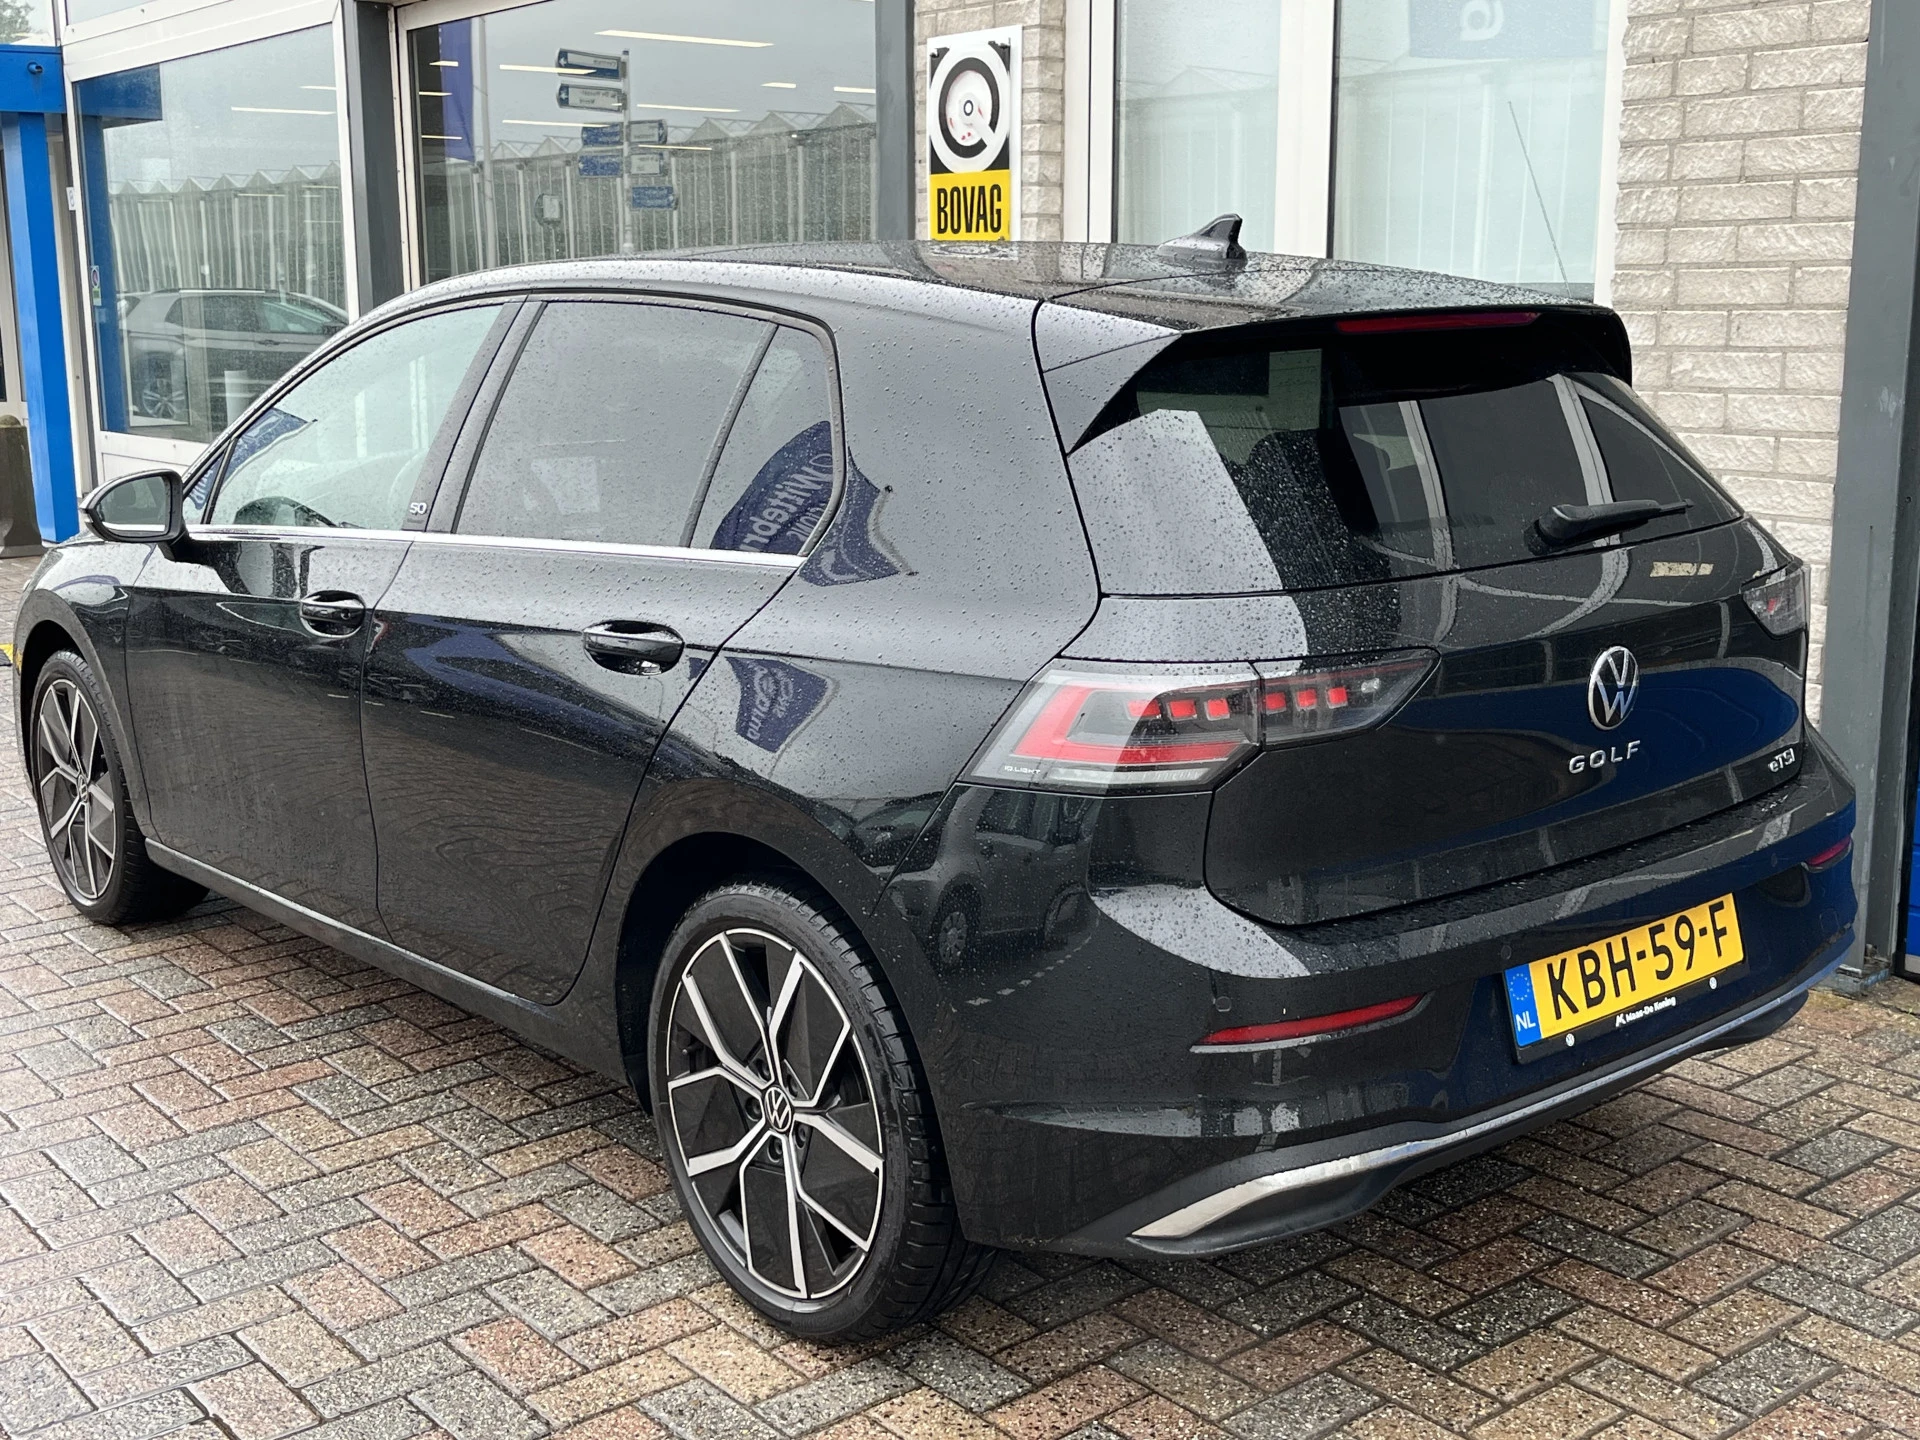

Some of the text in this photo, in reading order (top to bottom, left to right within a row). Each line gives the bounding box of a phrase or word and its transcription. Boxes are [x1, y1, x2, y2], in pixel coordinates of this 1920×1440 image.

[937, 184, 1002, 235] BOVAG
[409, 502, 427, 514] 50
[1568, 740, 1641, 774] GOLF
[1767, 747, 1796, 773] eTSI
[1547, 900, 1728, 1021] KBH-59-F
[1515, 1010, 1537, 1032] NL
